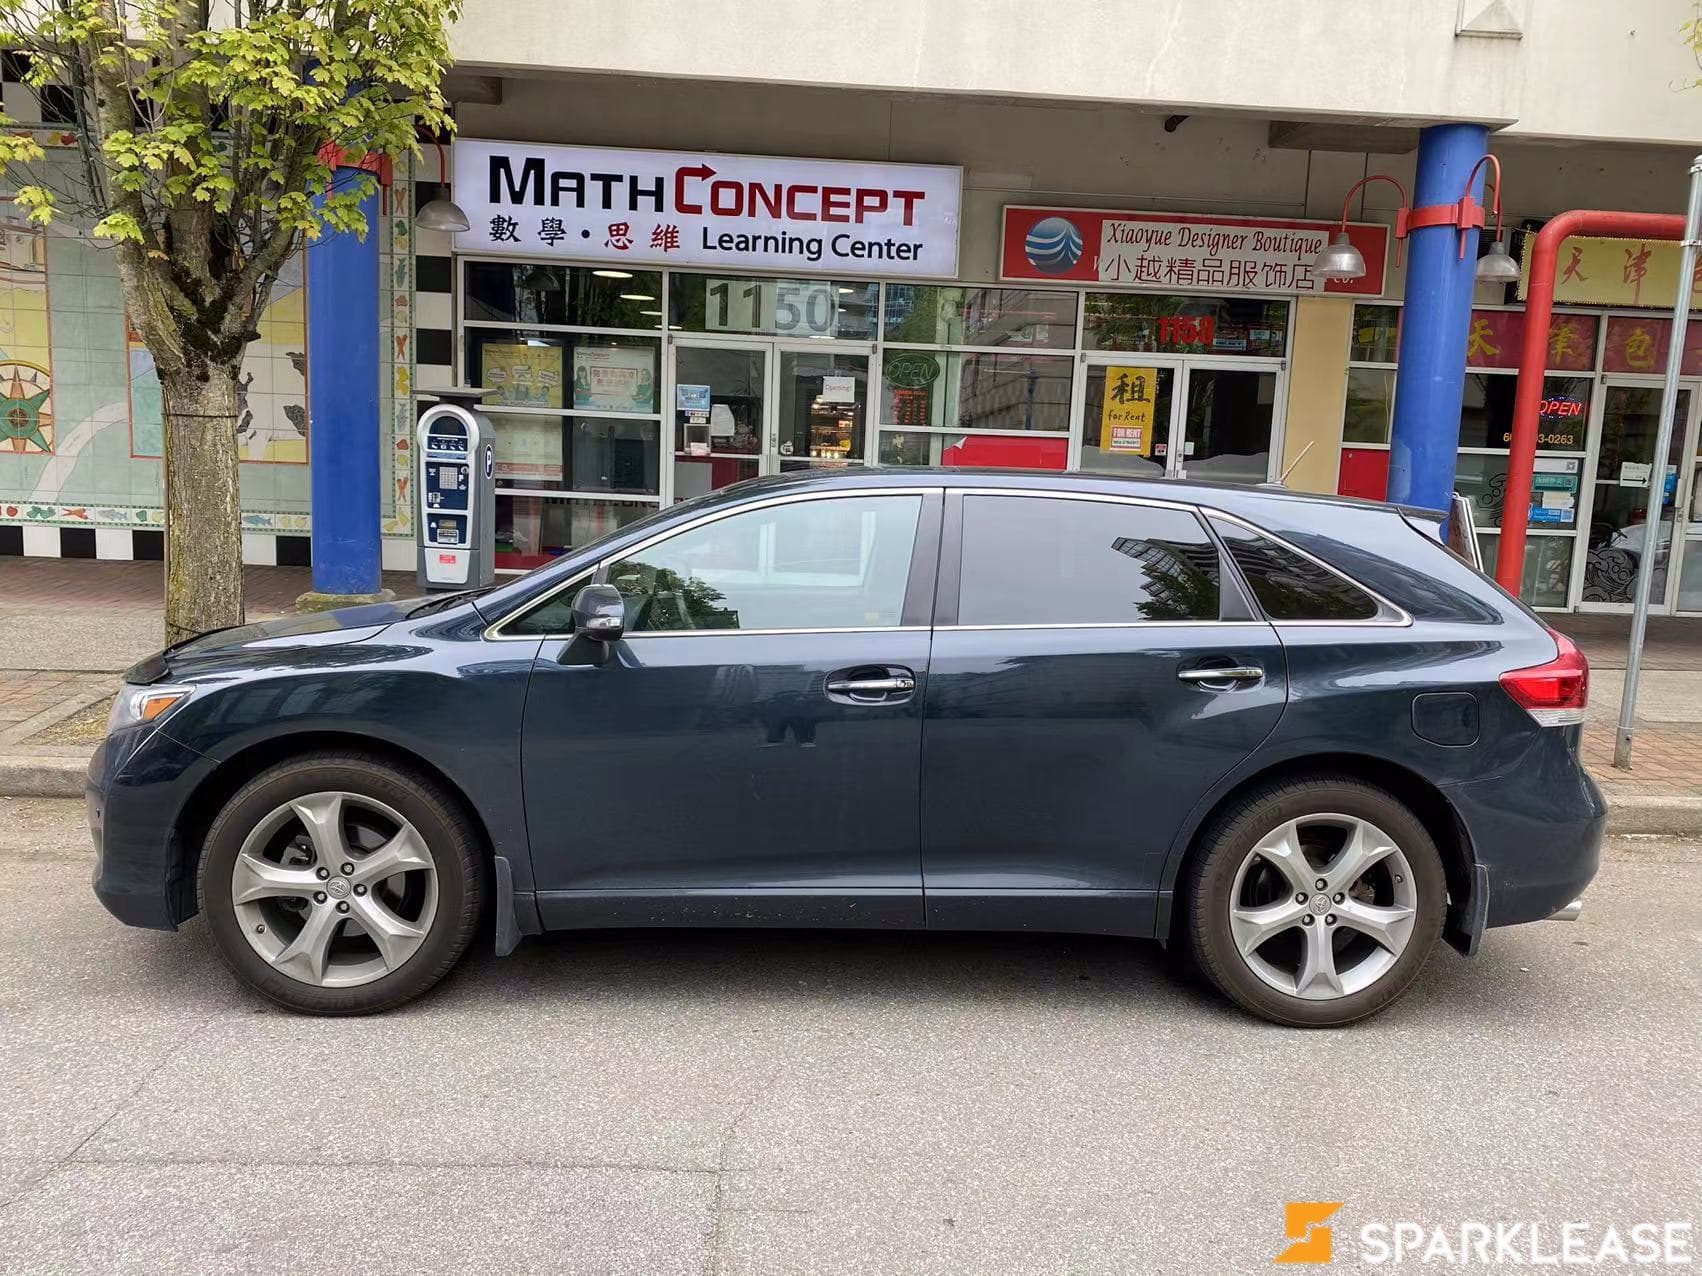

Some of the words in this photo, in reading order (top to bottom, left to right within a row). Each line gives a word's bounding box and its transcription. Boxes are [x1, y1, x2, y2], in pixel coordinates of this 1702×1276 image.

[703, 227, 823, 261] Learning
[831, 234, 923, 260] Center
[1107, 222, 1172, 253] Xiaoyue
[1178, 227, 1248, 256] Designer
[1252, 230, 1322, 260] Boutique
[1105, 253, 1315, 290] 小越精品服饰店
[710, 282, 836, 332] 1150
[889, 361, 935, 380] OPEN
[1110, 373, 1150, 404] 租
[1108, 410, 1124, 422] for
[1124, 411, 1146, 422] Rent
[1539, 400, 1583, 416] OPEN
[1113, 427, 1126, 437] FOR
[1126, 428, 1141, 437] RENT
